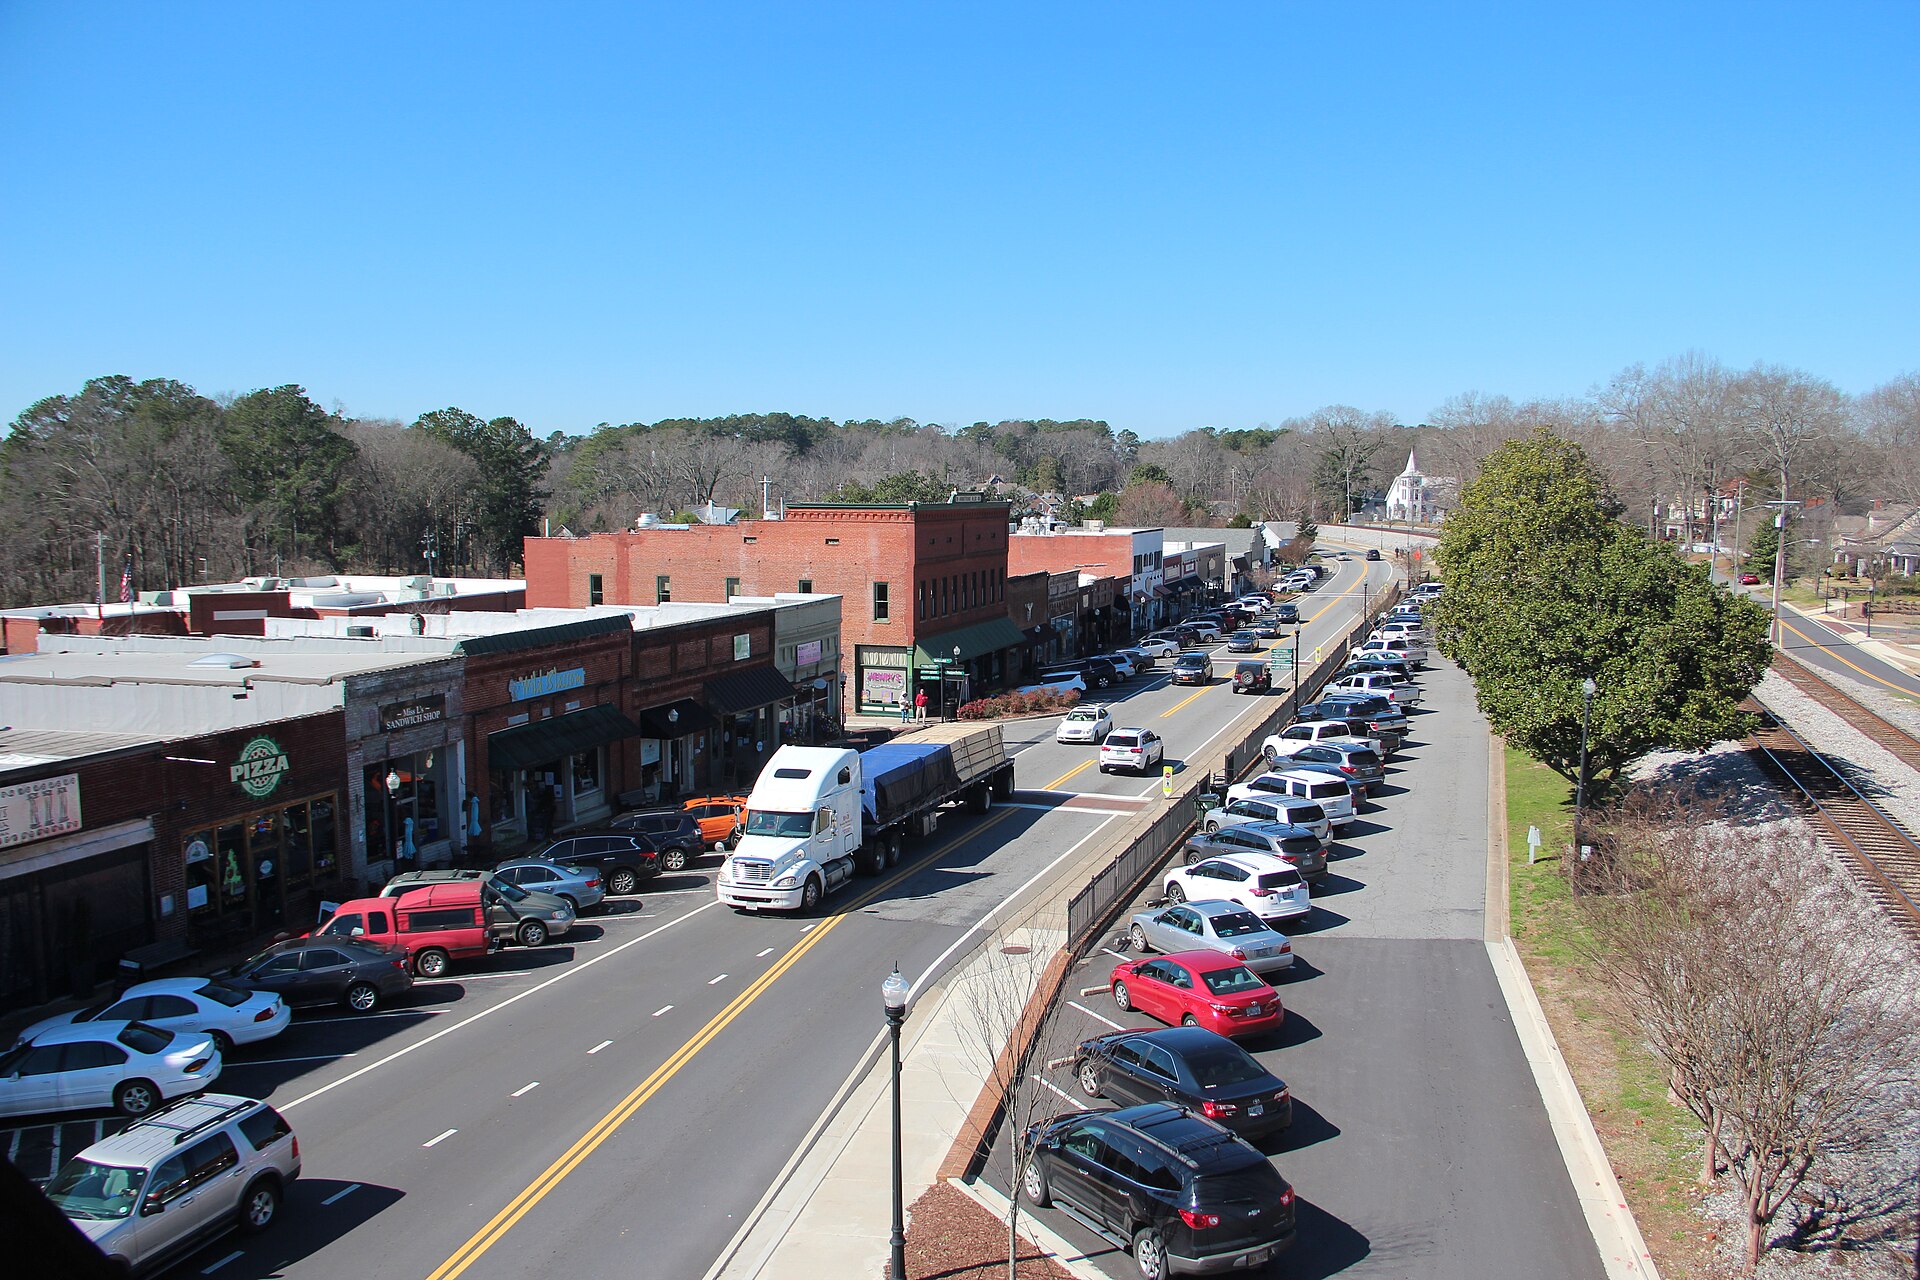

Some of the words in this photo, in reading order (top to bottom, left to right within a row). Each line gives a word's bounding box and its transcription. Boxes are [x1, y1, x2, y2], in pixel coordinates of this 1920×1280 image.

[386, 714, 423, 730] SANDWICH
[423, 710, 441, 722] SHOP
[402, 708, 416, 717] Miss
[416, 705, 424, 714] L's
[230, 754, 290, 783] PIZZA
